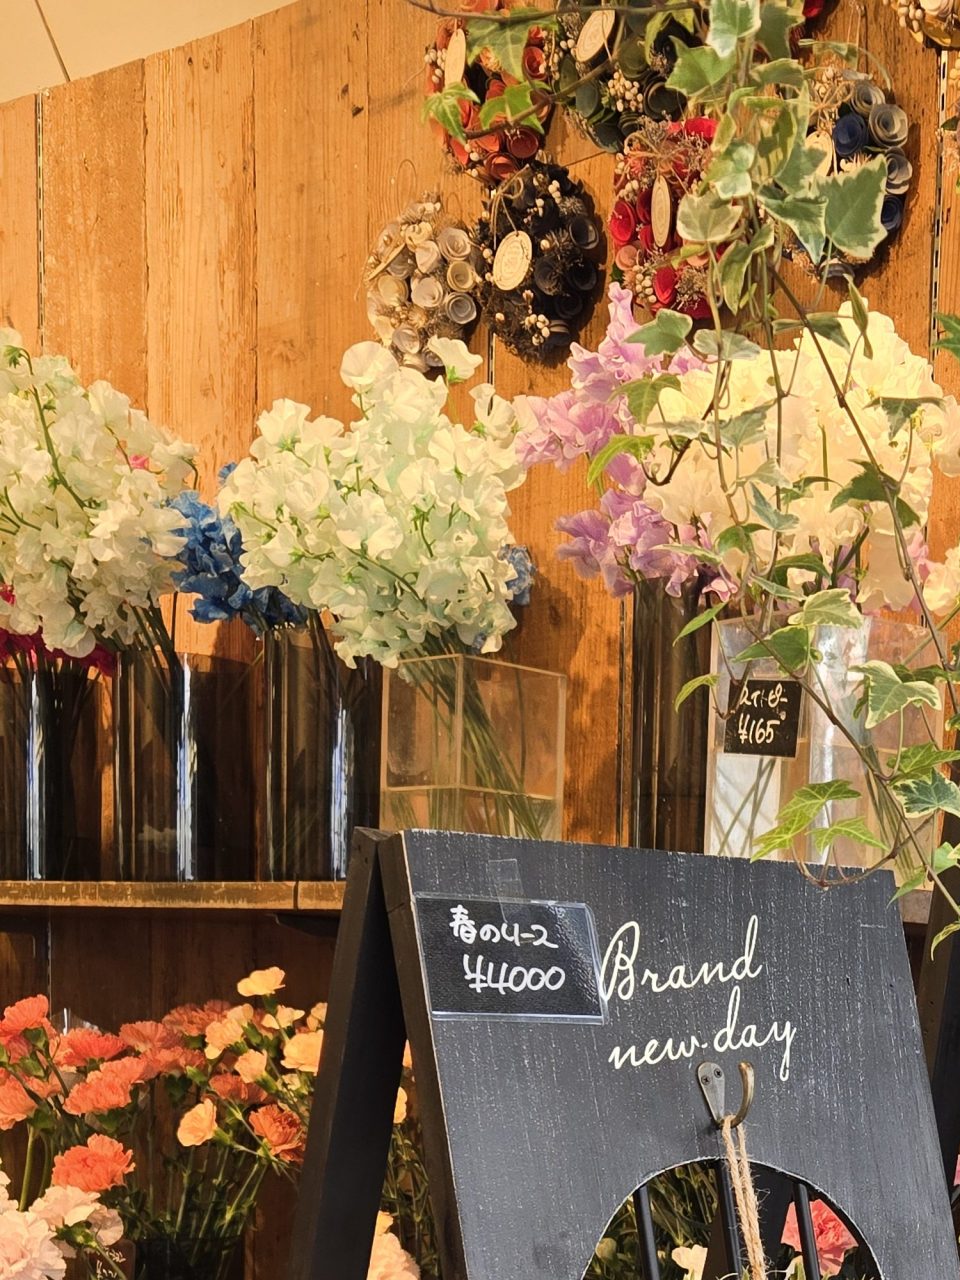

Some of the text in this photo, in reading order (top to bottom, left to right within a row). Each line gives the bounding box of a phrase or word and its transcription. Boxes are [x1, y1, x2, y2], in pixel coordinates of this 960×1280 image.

[738, 713, 781, 744] ¥165
[463, 954, 566, 994] ¥4000
[601, 915, 762, 1000] Brand
[610, 985, 797, 1082] new day
